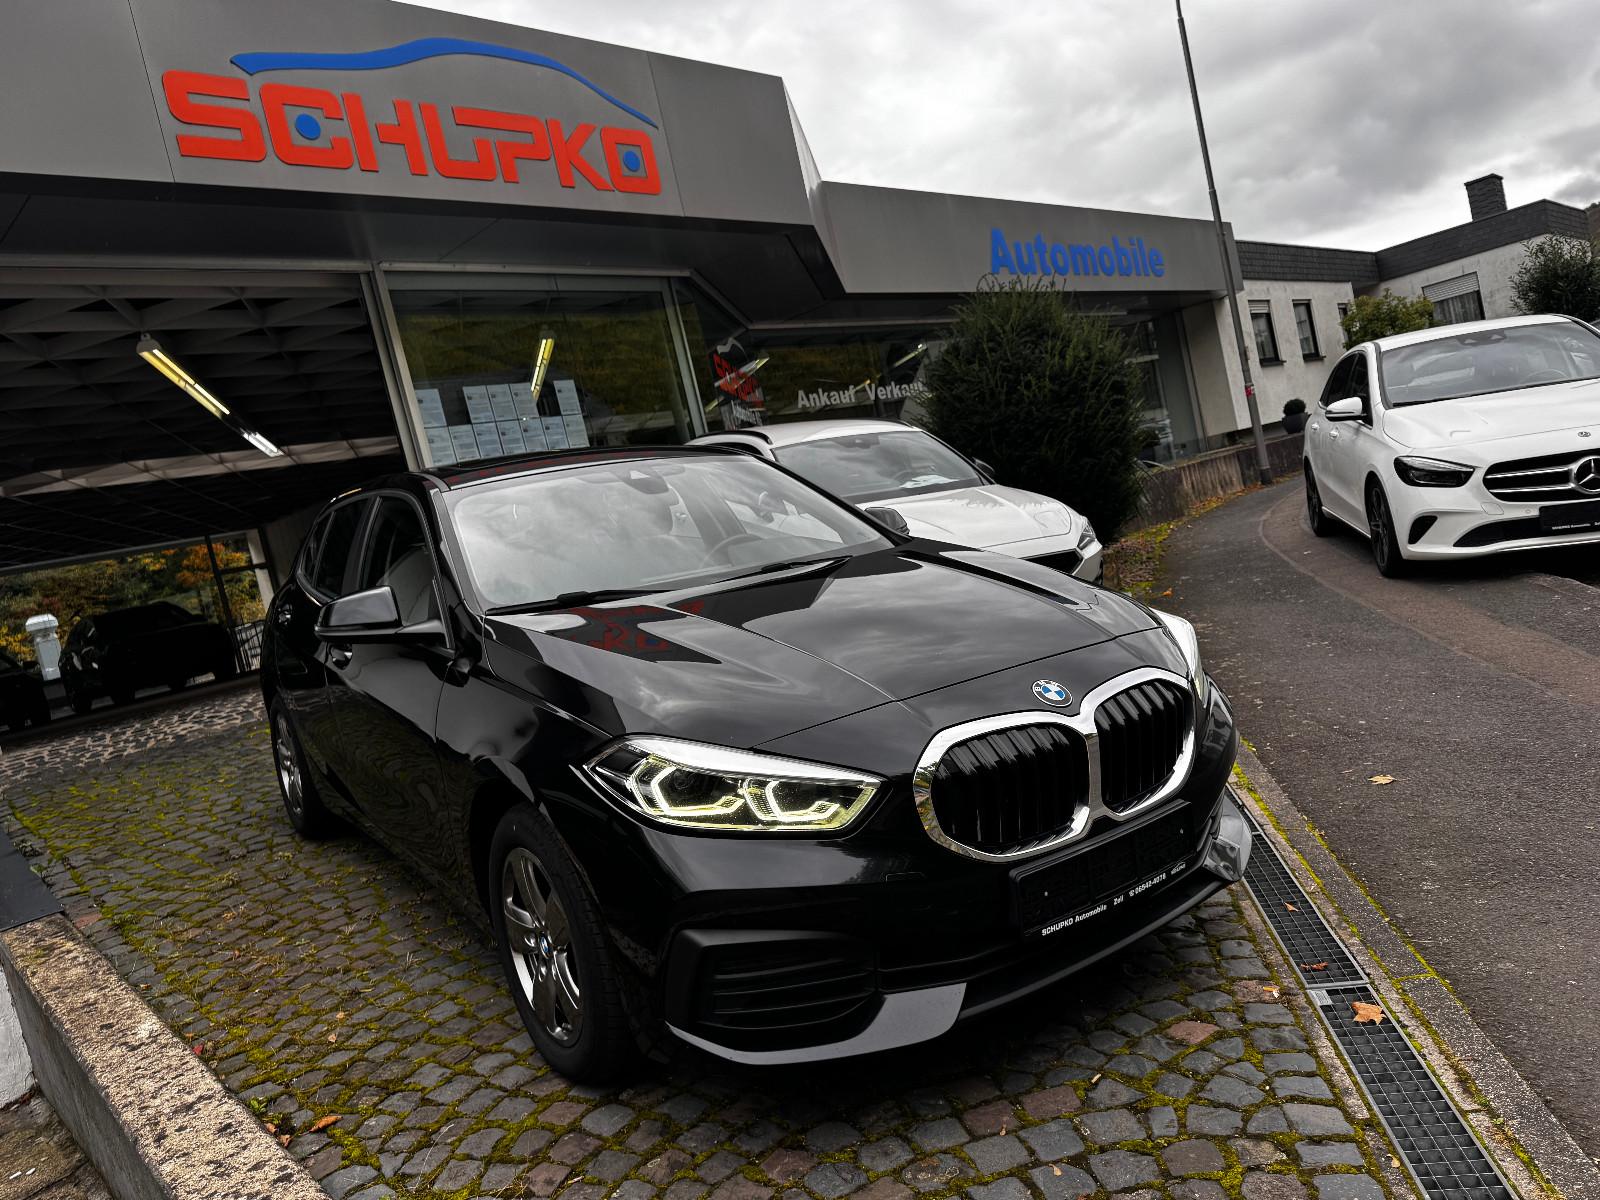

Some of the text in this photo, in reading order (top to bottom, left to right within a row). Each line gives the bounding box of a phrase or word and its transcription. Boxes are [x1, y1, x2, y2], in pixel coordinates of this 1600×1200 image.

[162, 70, 662, 196] SCHUPKO
[991, 227, 1166, 277] Automobile
[797, 384, 856, 409] Ankauf
[1041, 917, 1074, 936] SCHUPKO
[1074, 904, 1108, 923] Automobile
[1113, 894, 1124, 906] Zell
